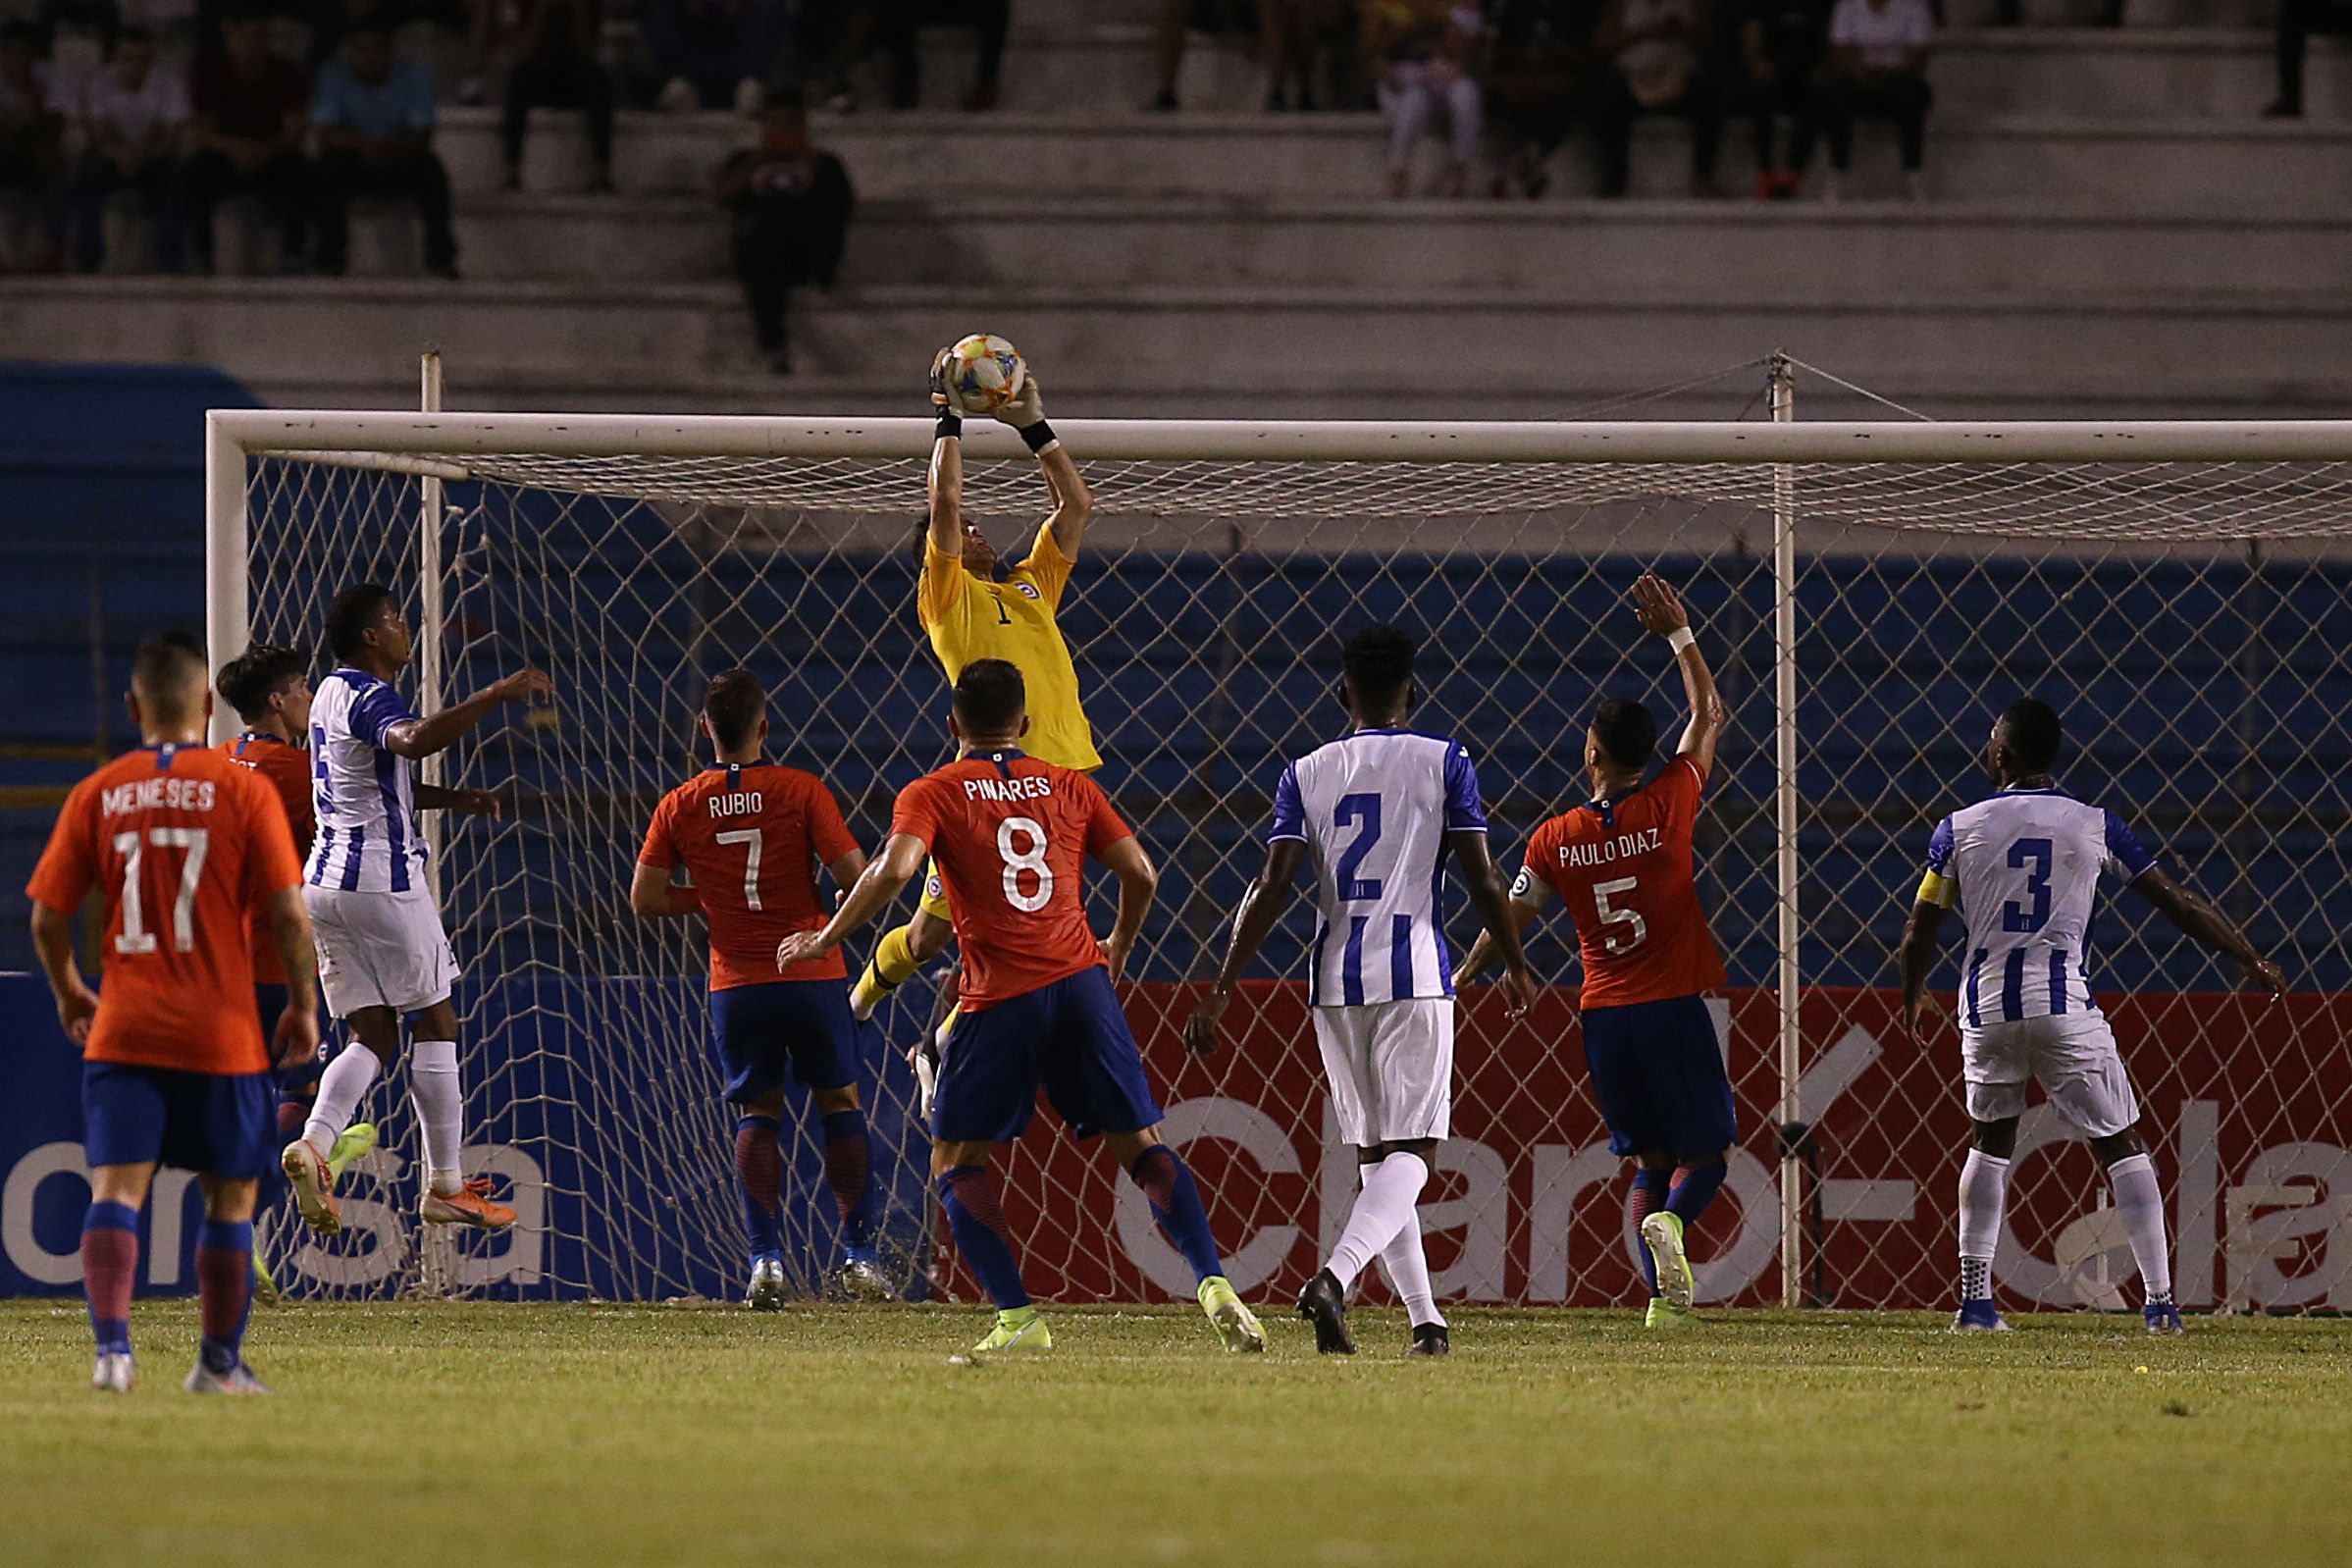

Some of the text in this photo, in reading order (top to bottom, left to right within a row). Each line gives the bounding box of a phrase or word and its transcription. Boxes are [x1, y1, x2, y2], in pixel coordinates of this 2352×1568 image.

[991, 595, 1012, 625] 1
[101, 776, 216, 819] MENESES
[708, 792, 762, 818] RUBIO
[964, 776, 1052, 802] PINARES
[715, 828, 762, 911] 7
[997, 816, 1054, 913] 8
[1334, 793, 1382, 902] 2
[1559, 827, 1663, 868] PAULO DIAZ
[2003, 837, 2052, 933] 3
[113, 826, 209, 954] 17
[1593, 875, 1646, 955] 5
